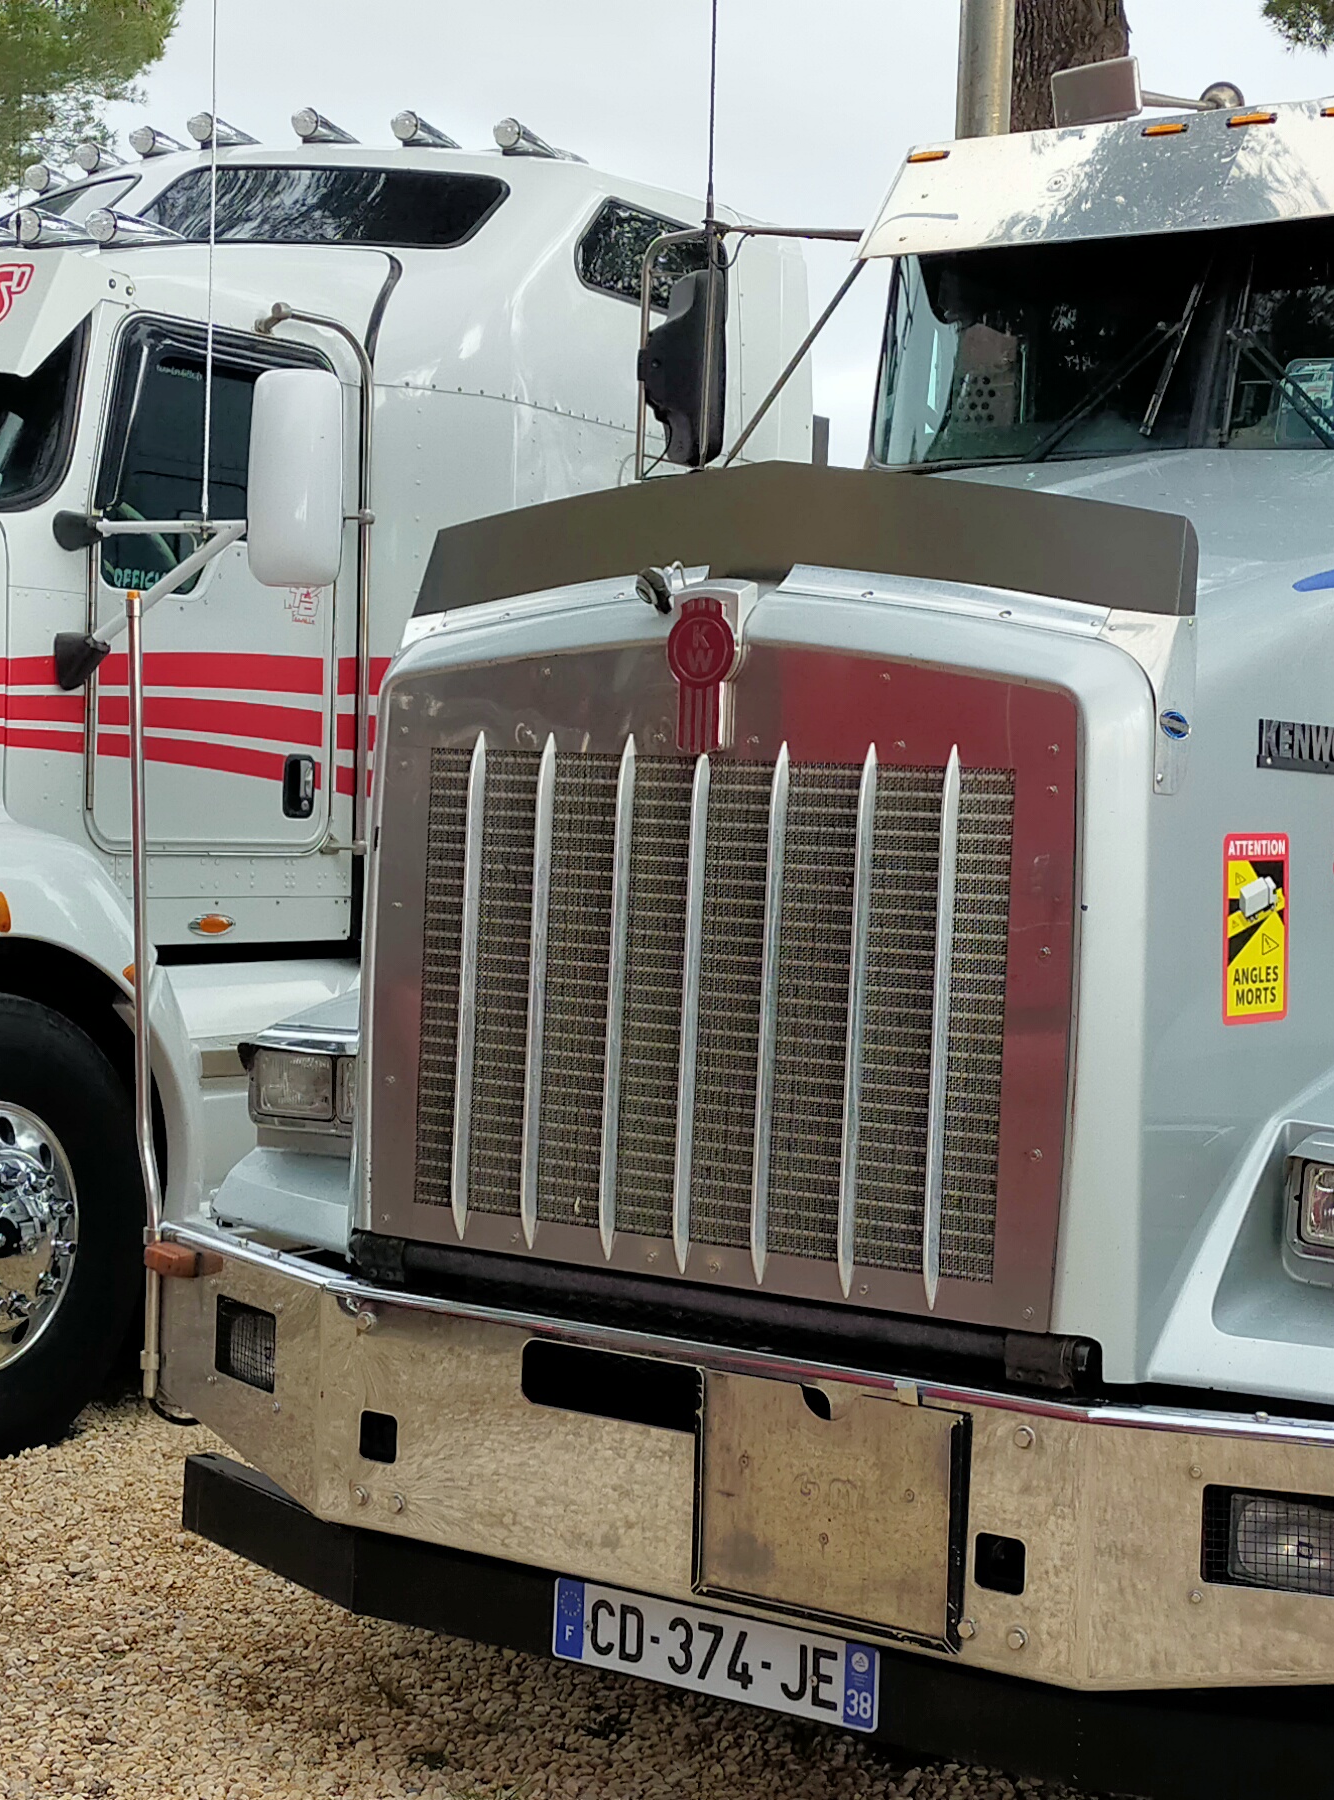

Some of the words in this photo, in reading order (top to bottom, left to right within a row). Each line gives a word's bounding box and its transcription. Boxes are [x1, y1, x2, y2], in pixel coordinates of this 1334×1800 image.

[1228, 838, 1286, 856] ATTENTION
[1232, 965, 1279, 986] ANGLES
[1235, 986, 1277, 1007] MORTS
[564, 1625, 575, 1641] F
[590, 1599, 838, 1712] CD-374-JE
[846, 1688, 872, 1719] 38
